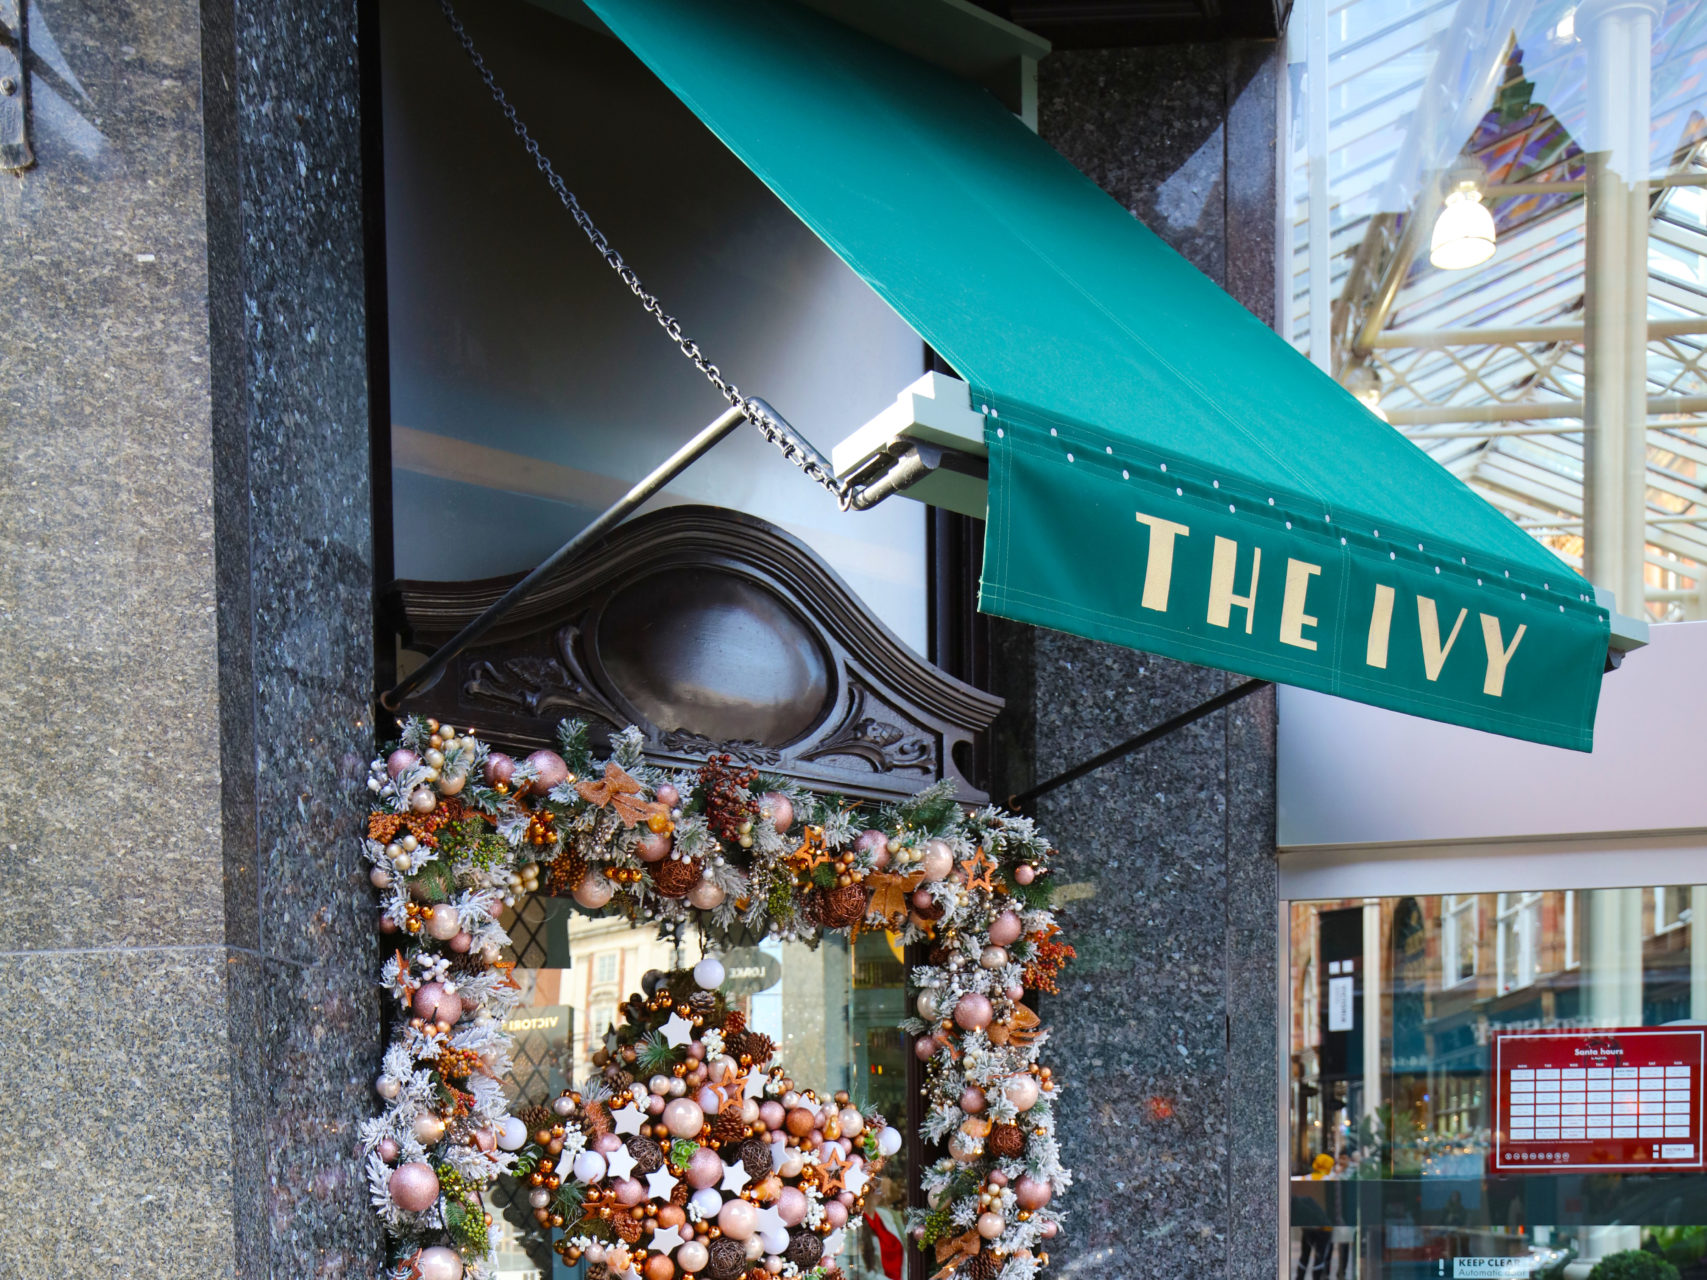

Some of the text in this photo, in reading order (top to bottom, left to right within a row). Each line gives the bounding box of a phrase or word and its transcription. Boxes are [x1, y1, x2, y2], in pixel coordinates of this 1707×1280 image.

[1135, 511, 1528, 697] THE IVY
[1574, 1048, 1598, 1056] Santa
[1459, 1259, 1521, 1267] KEEP CLEAR
[1458, 1269, 1502, 1277] Automatic
